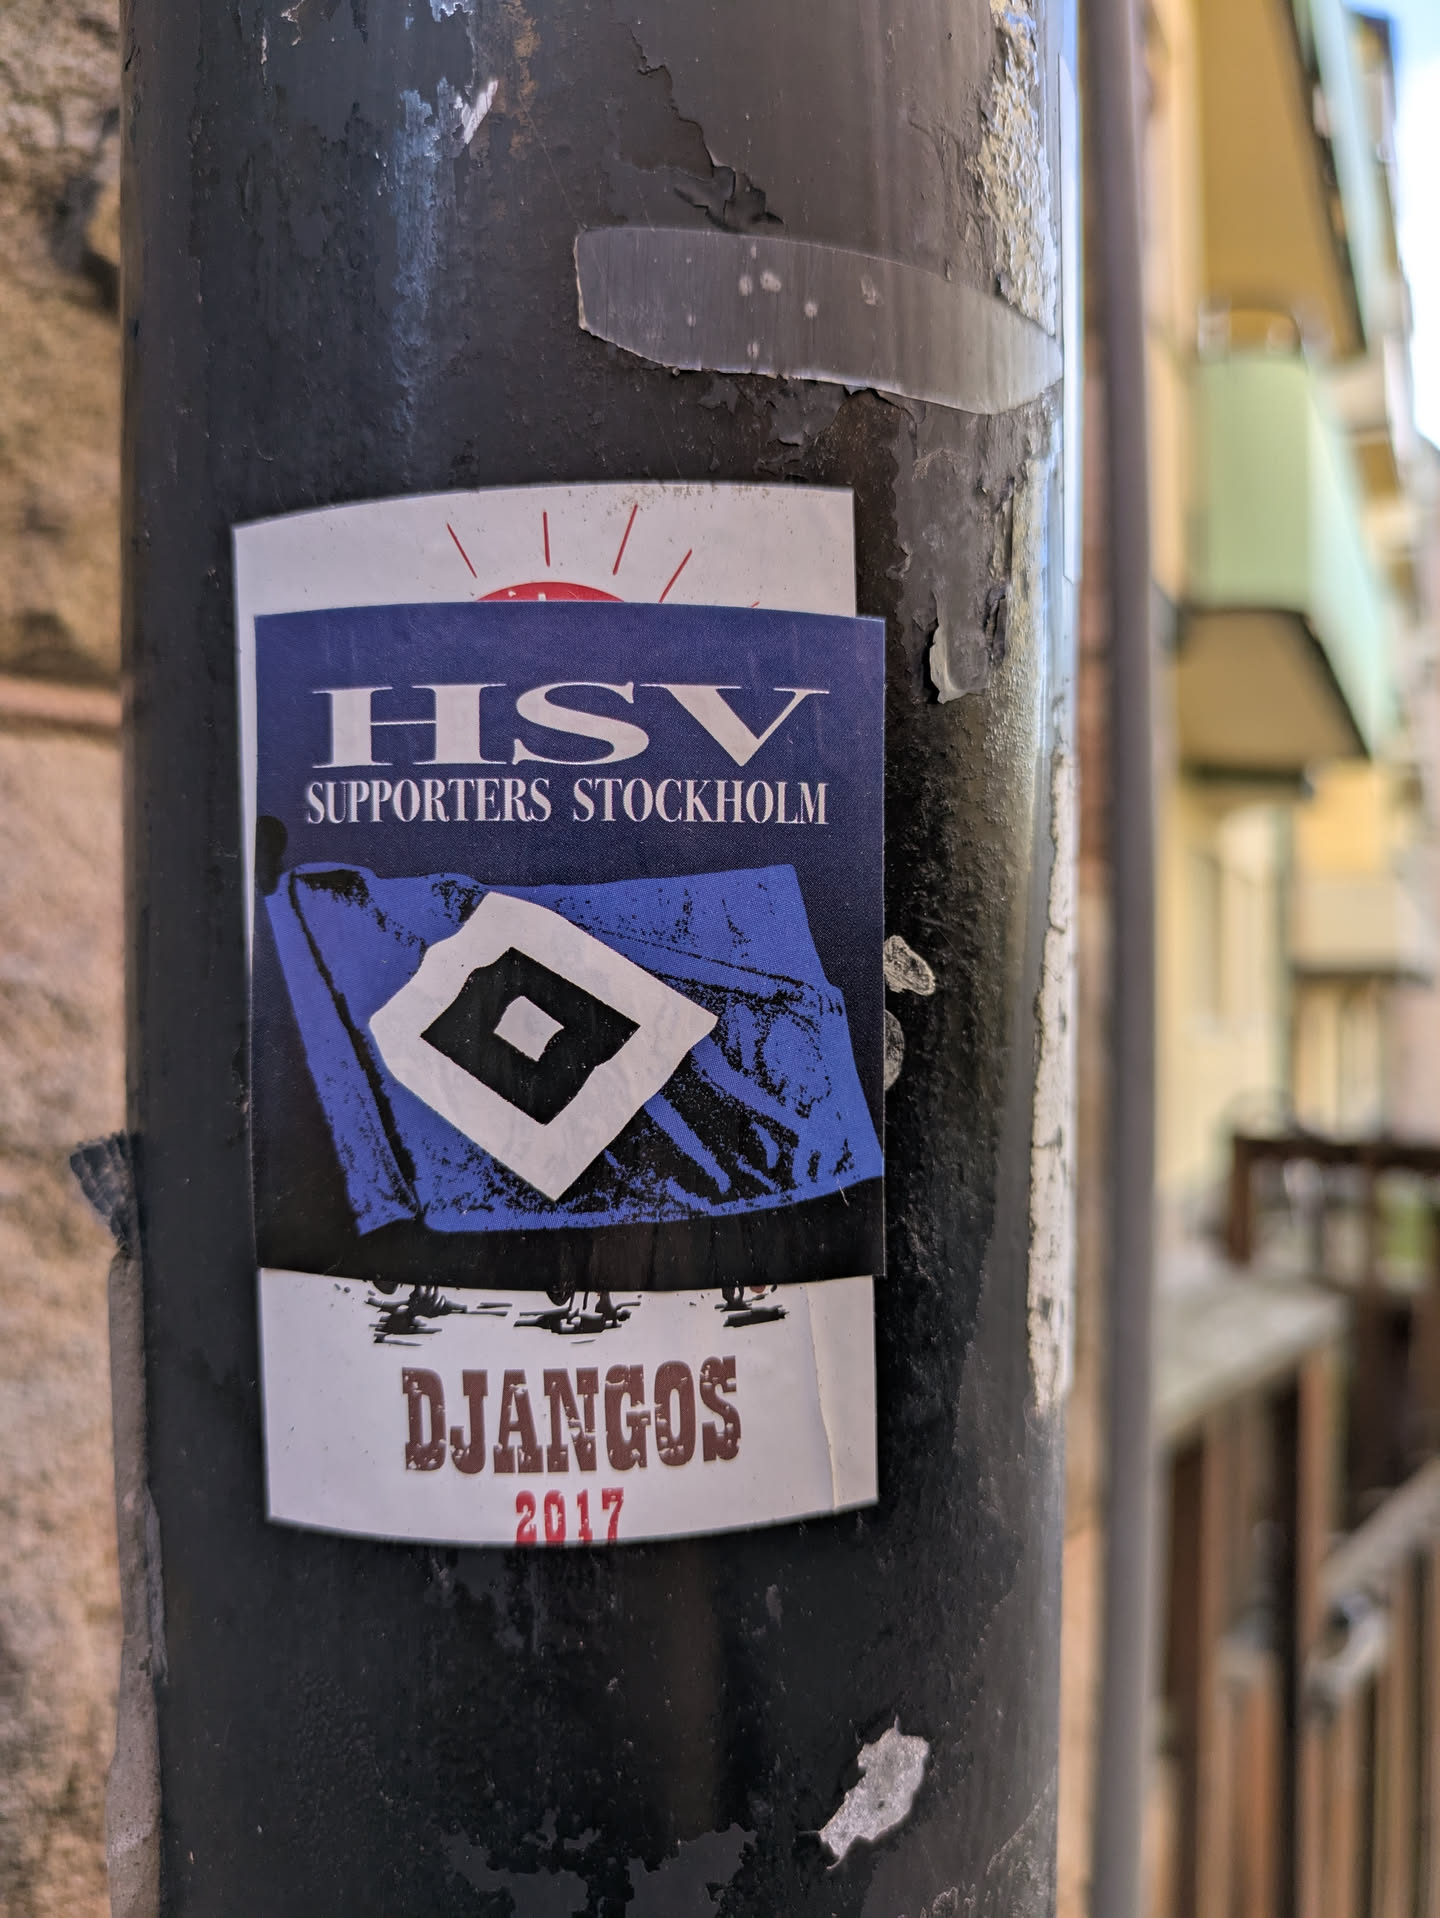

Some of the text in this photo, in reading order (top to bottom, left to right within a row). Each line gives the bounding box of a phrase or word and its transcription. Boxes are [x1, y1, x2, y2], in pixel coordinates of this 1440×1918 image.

[311, 681, 830, 769] HSV
[305, 777, 830, 826] SUPPORTERS STOCKHOLM
[401, 1355, 743, 1475] DJANGOS
[514, 1487, 627, 1546] 2017
